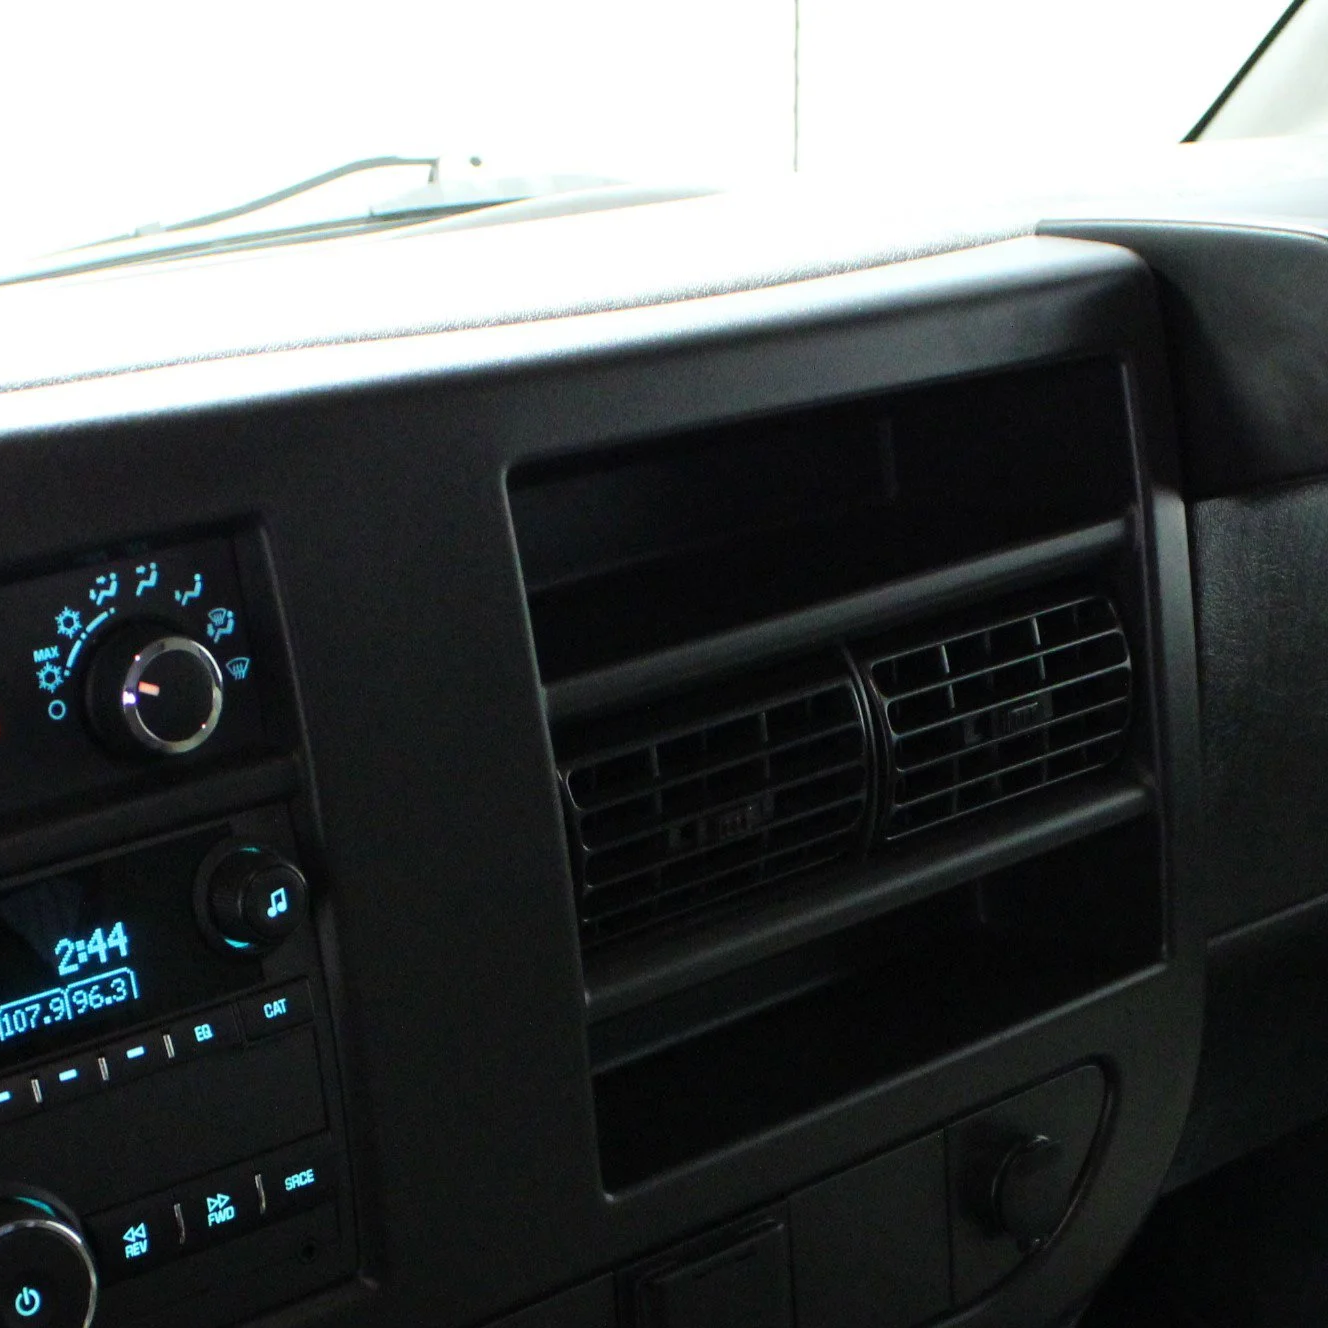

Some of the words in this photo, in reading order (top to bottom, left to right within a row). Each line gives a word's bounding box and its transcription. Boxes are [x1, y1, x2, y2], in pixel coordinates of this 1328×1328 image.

[33, 645, 60, 663] MAX
[55, 921, 129, 976] 2:44
[3, 997, 65, 1037] 107.9
[72, 977, 128, 1014] 96.3
[263, 998, 287, 1018] CAT
[194, 1024, 213, 1042] EQ
[284, 1168, 315, 1191] SRCE
[207, 1206, 235, 1227] FWD
[125, 1239, 148, 1259] REV
